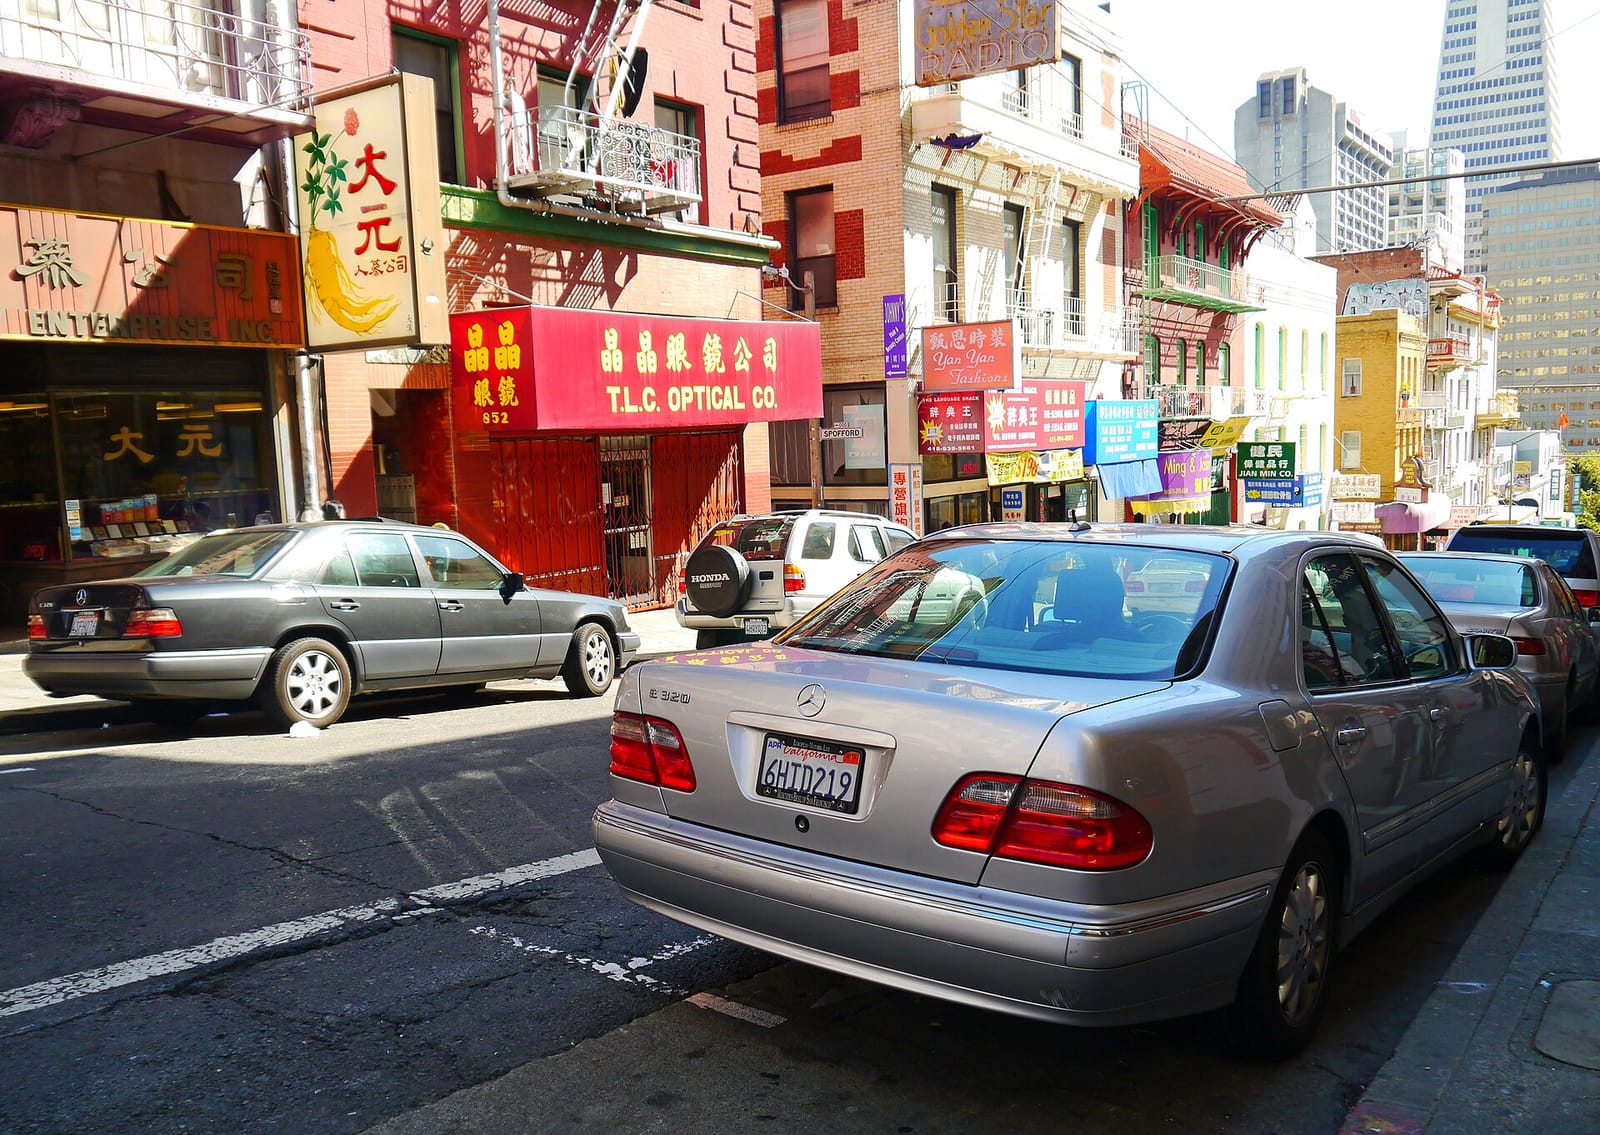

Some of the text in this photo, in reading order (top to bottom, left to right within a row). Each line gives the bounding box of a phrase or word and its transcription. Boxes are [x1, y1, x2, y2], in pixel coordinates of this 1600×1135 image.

[917, 0, 1052, 49] Golden Star
[921, 32, 1049, 81] RADIO
[348, 144, 402, 256] 大元
[464, 320, 521, 372] 晶晶
[601, 328, 777, 374] 晶晶眼鏡公司
[933, 349, 995, 371] Yan Yan
[950, 368, 1008, 385] Fashions
[474, 376, 519, 407] 眼鏡
[606, 385, 778, 413] T.L.C. OPTICAL CO.
[483, 412, 509, 424] 852
[104, 424, 223, 463] 大元
[823, 429, 860, 438] SPOFFORD
[1164, 458, 1186, 477] Ming
[1190, 456, 1196, 473] &
[691, 573, 730, 583] HONDA
[661, 690, 691, 704] 320
[768, 740, 783, 749] APR
[783, 745, 838, 762] California
[764, 758, 853, 801] 6HID219
